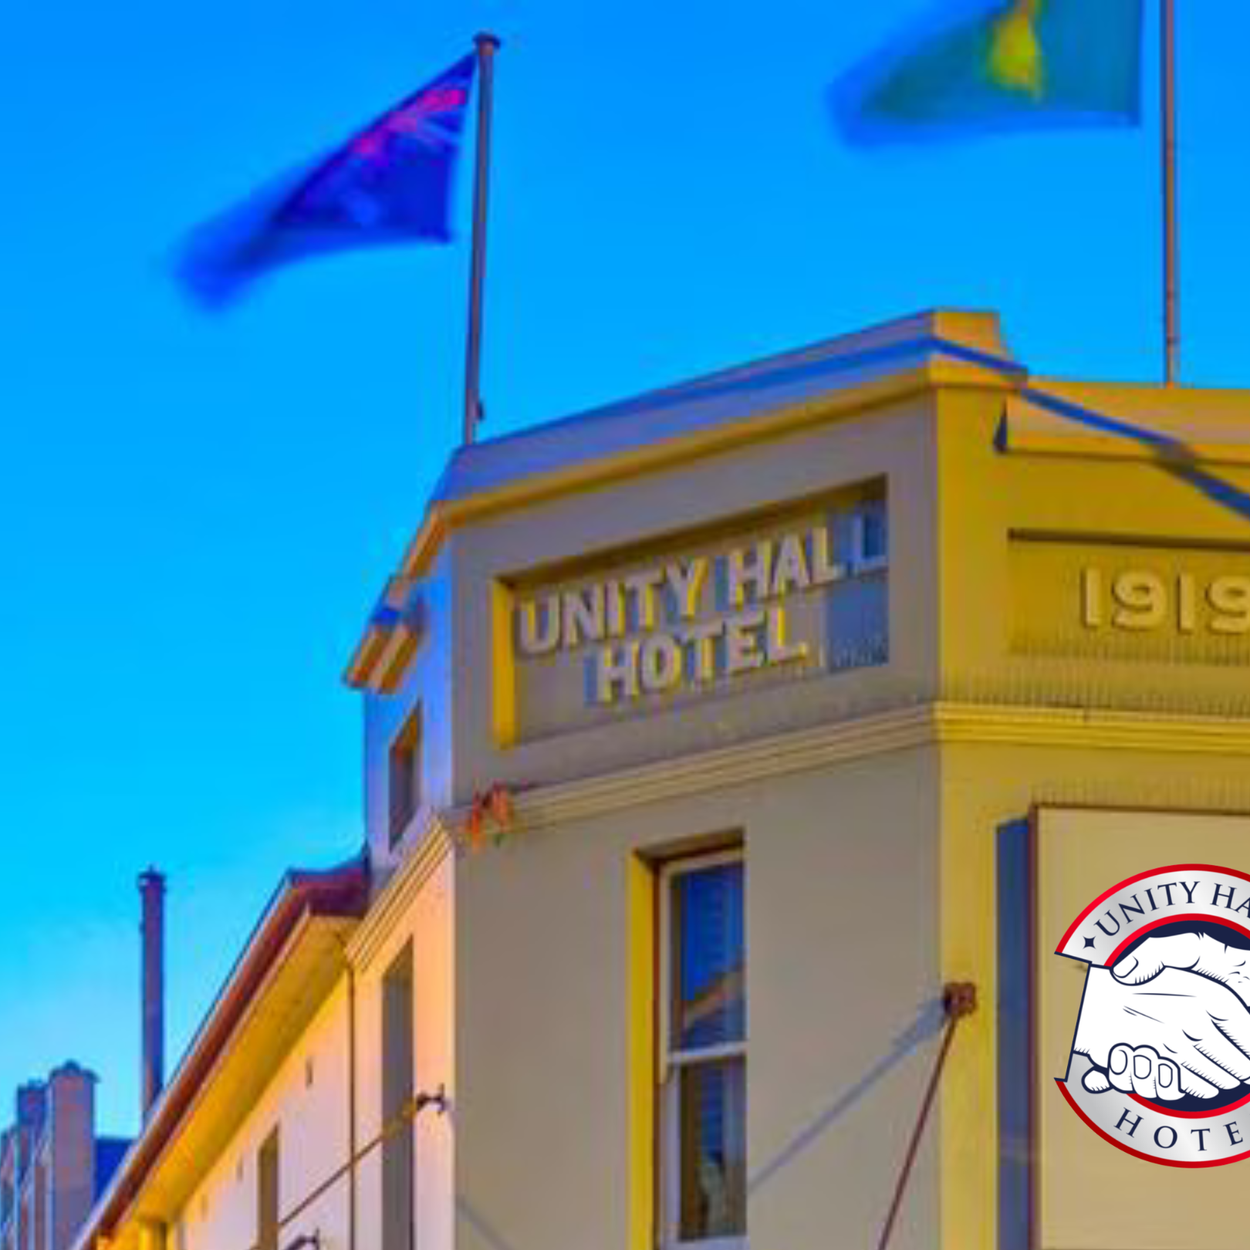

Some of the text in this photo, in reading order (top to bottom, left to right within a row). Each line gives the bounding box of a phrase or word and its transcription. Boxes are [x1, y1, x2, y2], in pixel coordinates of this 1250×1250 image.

[520, 514, 888, 656] UNITY HALL
[600, 610, 810, 702] HOTEL
[1094, 881, 1201, 937] UNITY
